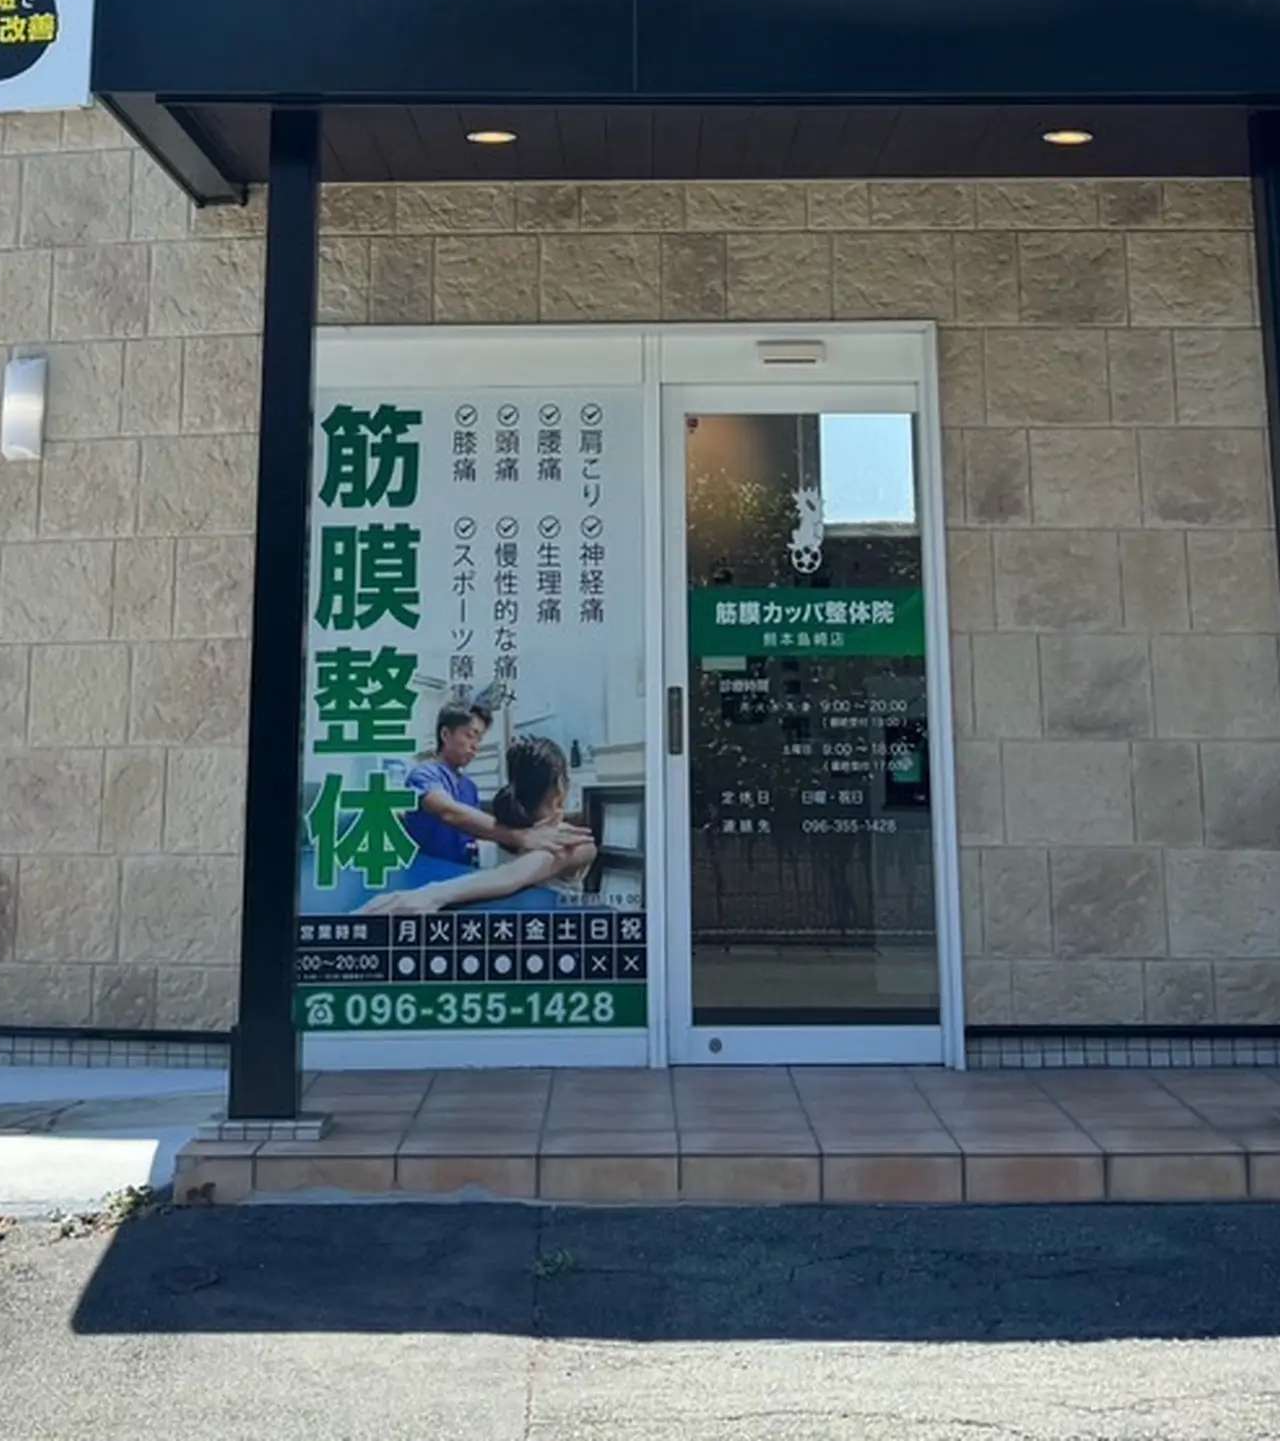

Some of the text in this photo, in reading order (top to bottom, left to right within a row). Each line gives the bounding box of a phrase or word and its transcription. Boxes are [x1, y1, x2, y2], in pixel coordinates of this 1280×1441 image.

[452, 430, 477, 482] 膝痛
[494, 430, 520, 482] 頭痛
[537, 430, 562, 482] 腰痛
[579, 430, 603, 508] 肩こり
[537, 542, 562, 624] 生理痛
[579, 542, 605, 624] 神経痛
[493, 542, 519, 706] 慢性的な痛み
[715, 601, 895, 625] 筋膜カッパ整体院
[305, 403, 423, 891] 筋膜整体
[398, 920, 417, 942] 月
[429, 919, 450, 942] 火
[460, 919, 482, 941] 水
[493, 919, 514, 941] 木
[525, 918, 547, 940] 金
[558, 919, 578, 940] 土
[590, 918, 609, 939] 日
[620, 918, 642, 940] 祝
[344, 991, 615, 1025] 096-355-1428
